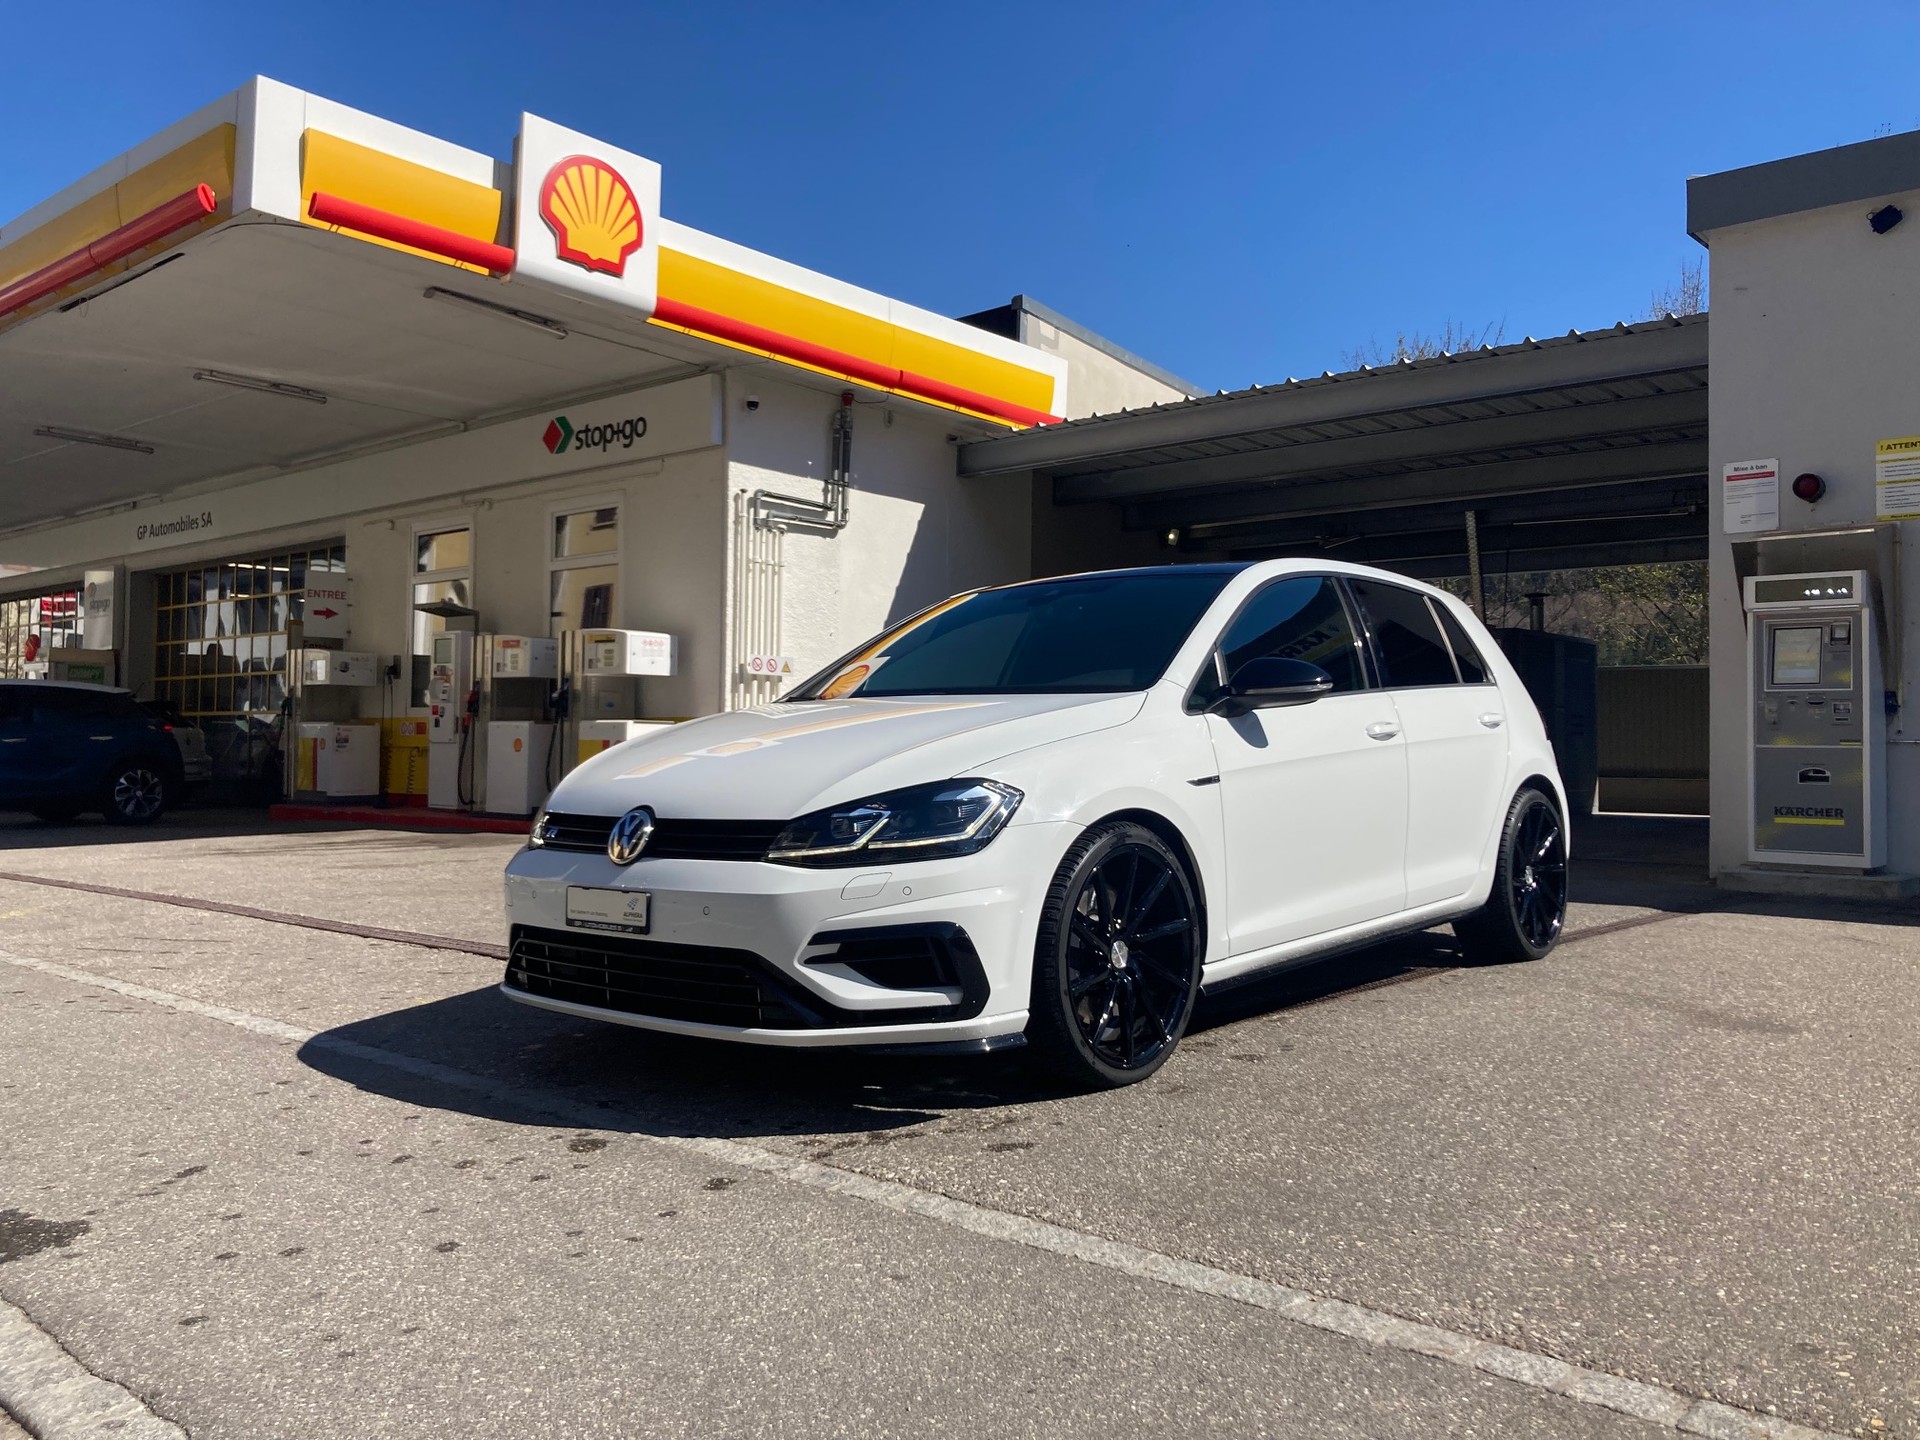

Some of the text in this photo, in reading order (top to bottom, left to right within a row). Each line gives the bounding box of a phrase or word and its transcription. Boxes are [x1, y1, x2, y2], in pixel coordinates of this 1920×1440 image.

[575, 417, 647, 452] stop+go
[137, 511, 213, 540] GP Automobiles SA
[1774, 806, 1844, 818] KÄRCHER
